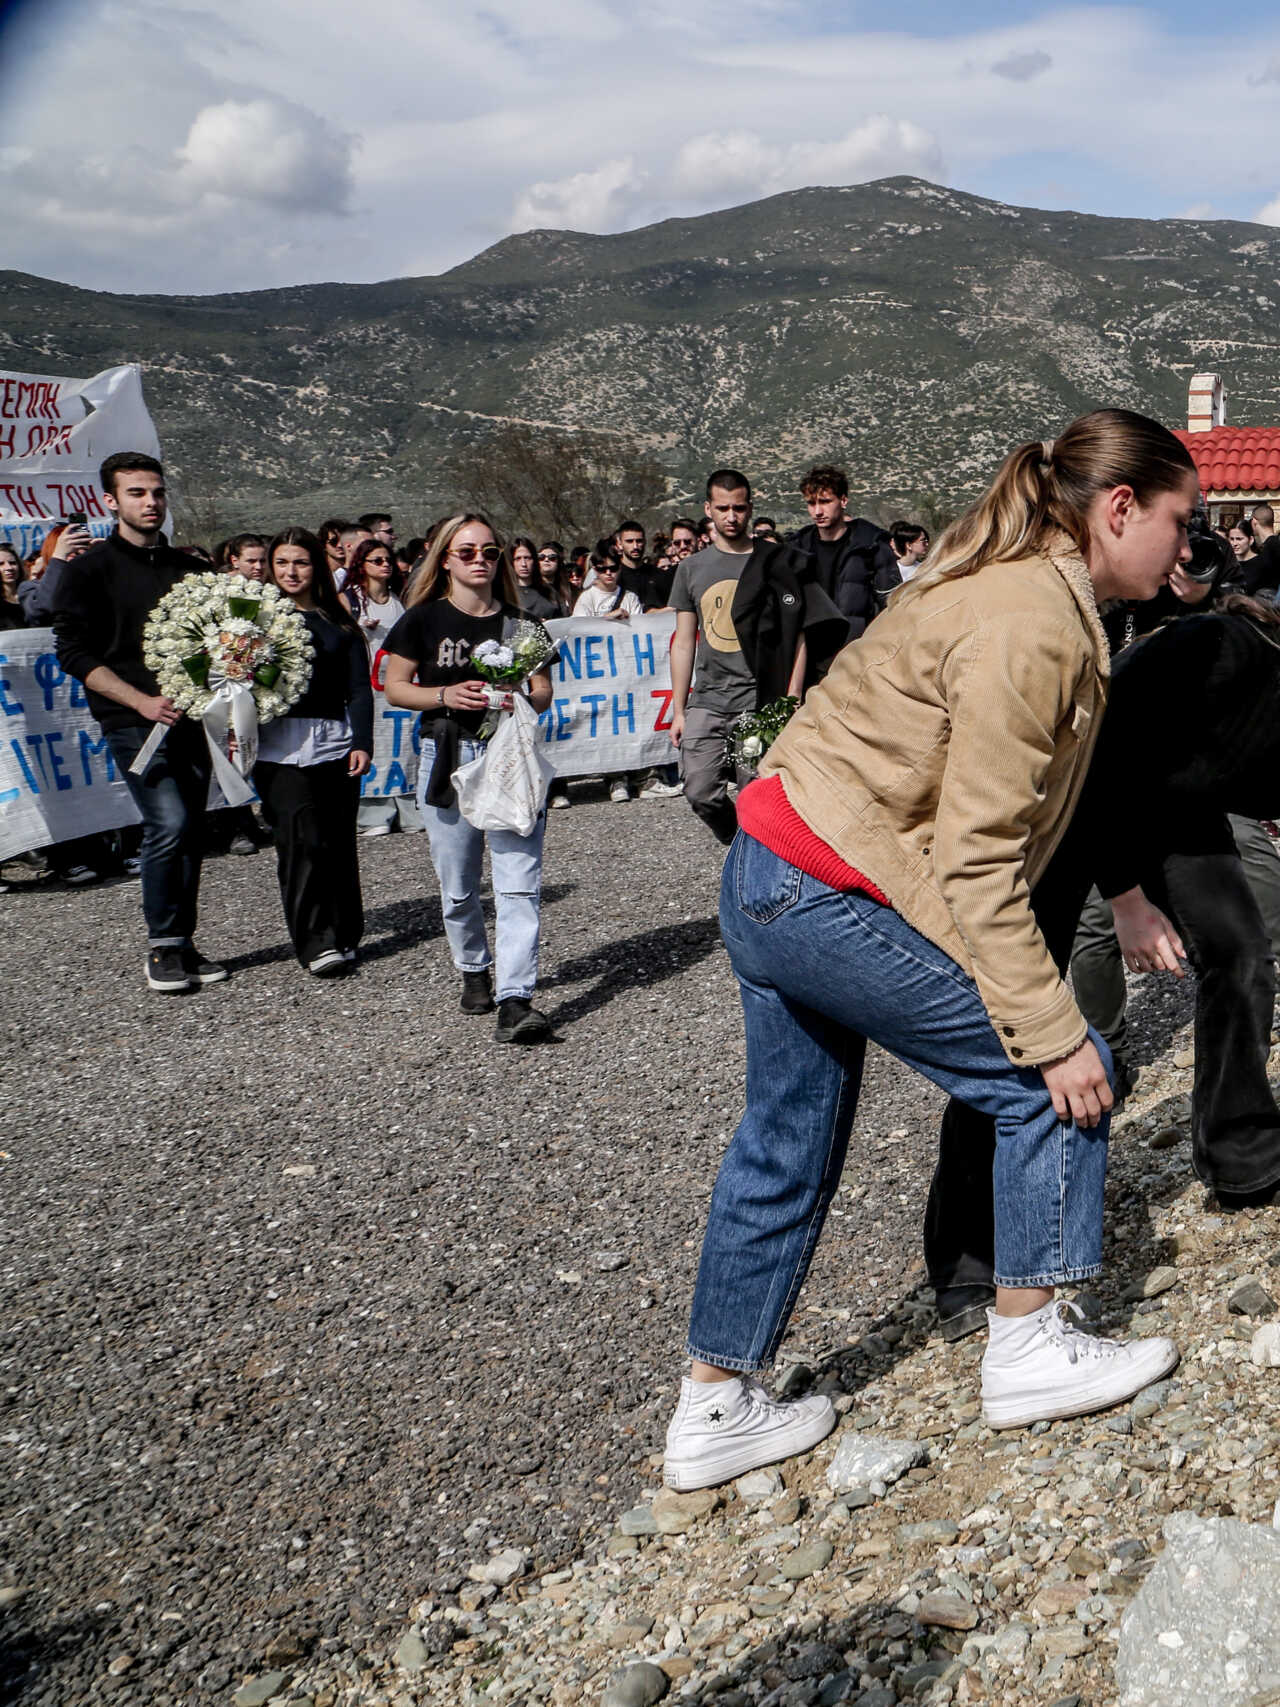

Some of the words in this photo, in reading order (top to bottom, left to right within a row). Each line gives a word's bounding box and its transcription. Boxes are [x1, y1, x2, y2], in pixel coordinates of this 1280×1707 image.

[551, 634, 618, 682] ΝΕΙ
[632, 633, 655, 676] Η
[580, 692, 636, 738] ΤΗ
